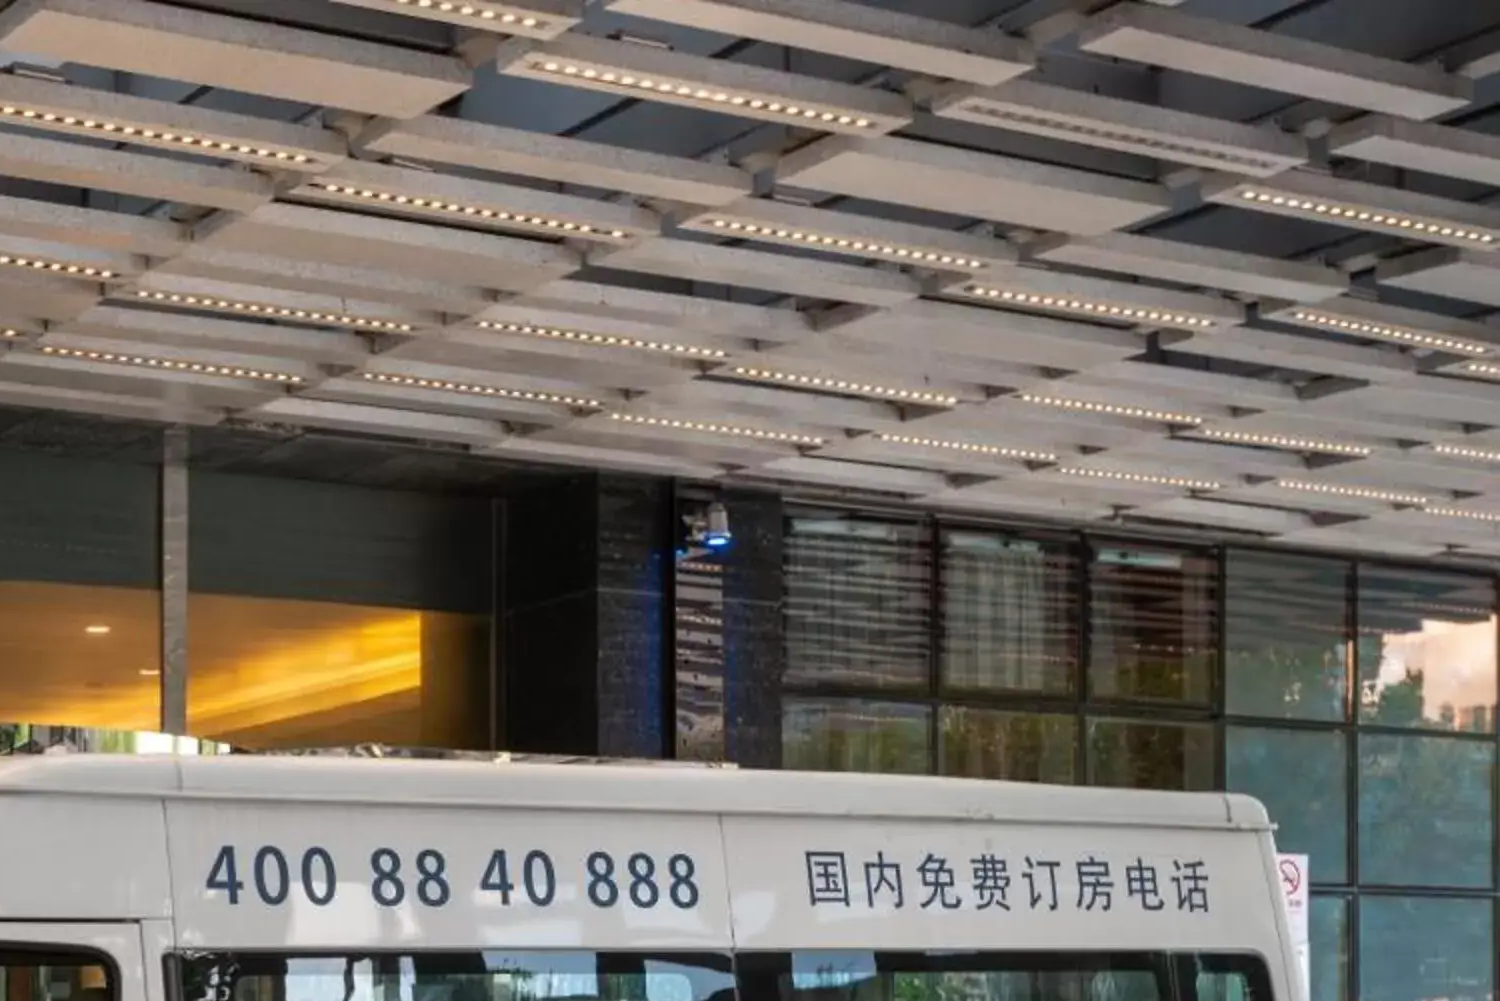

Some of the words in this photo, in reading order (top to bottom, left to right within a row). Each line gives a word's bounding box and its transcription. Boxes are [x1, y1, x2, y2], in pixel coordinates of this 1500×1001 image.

[206, 845, 337, 906] 400
[370, 847, 450, 907] 88
[480, 849, 556, 907] 40
[586, 851, 699, 909] 888
[805, 851, 1209, 913] 国内免费订房电话
